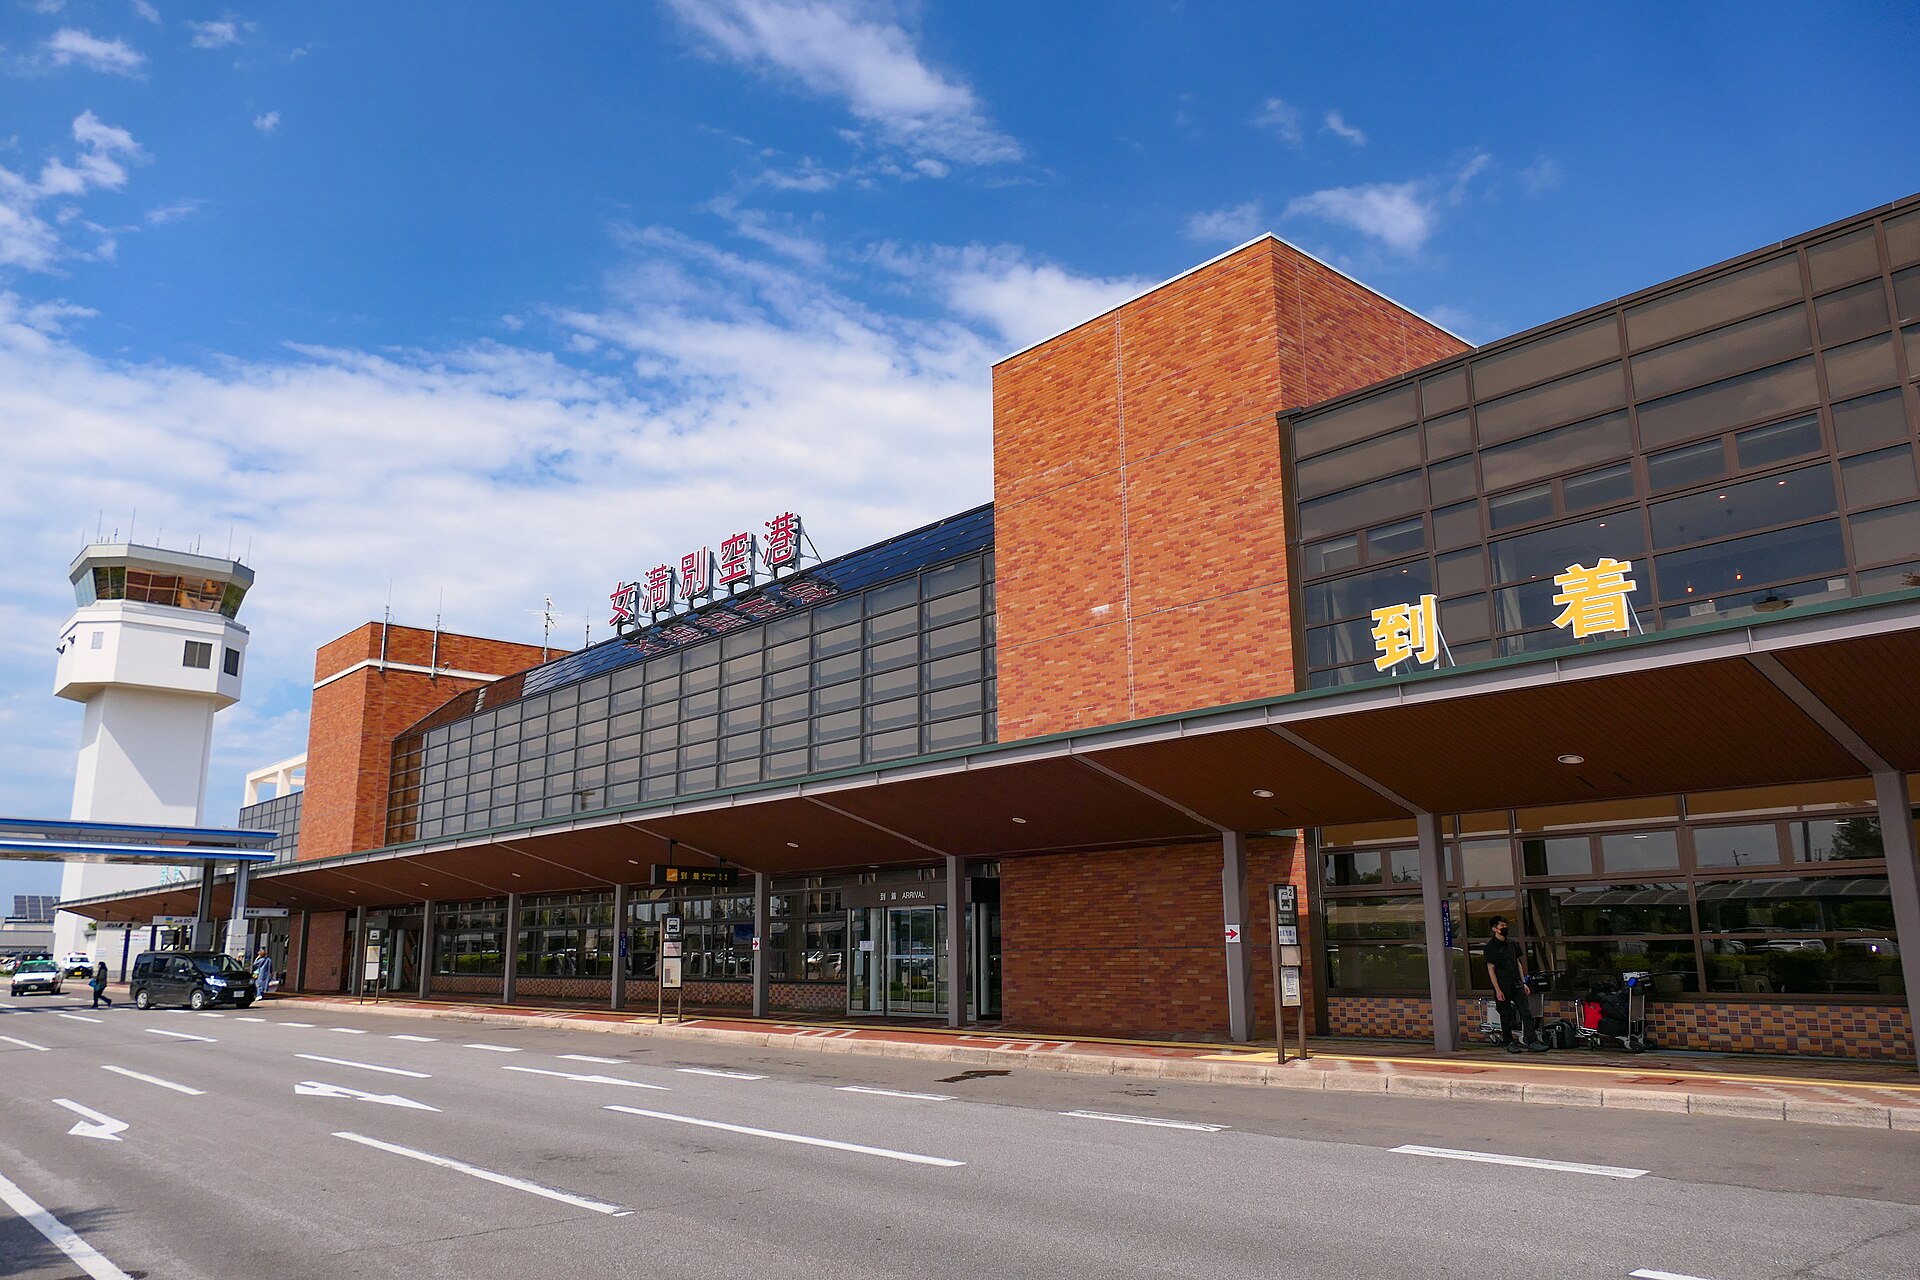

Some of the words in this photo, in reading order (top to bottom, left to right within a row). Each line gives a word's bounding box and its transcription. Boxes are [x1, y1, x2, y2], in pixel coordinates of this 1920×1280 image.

[608, 510, 796, 626] 女満別空港
[1371, 557, 1637, 672] 到着
[879, 891, 897, 901] 到着
[901, 891, 926, 899] ARRIVAL
[1288, 888, 1293, 897] 2
